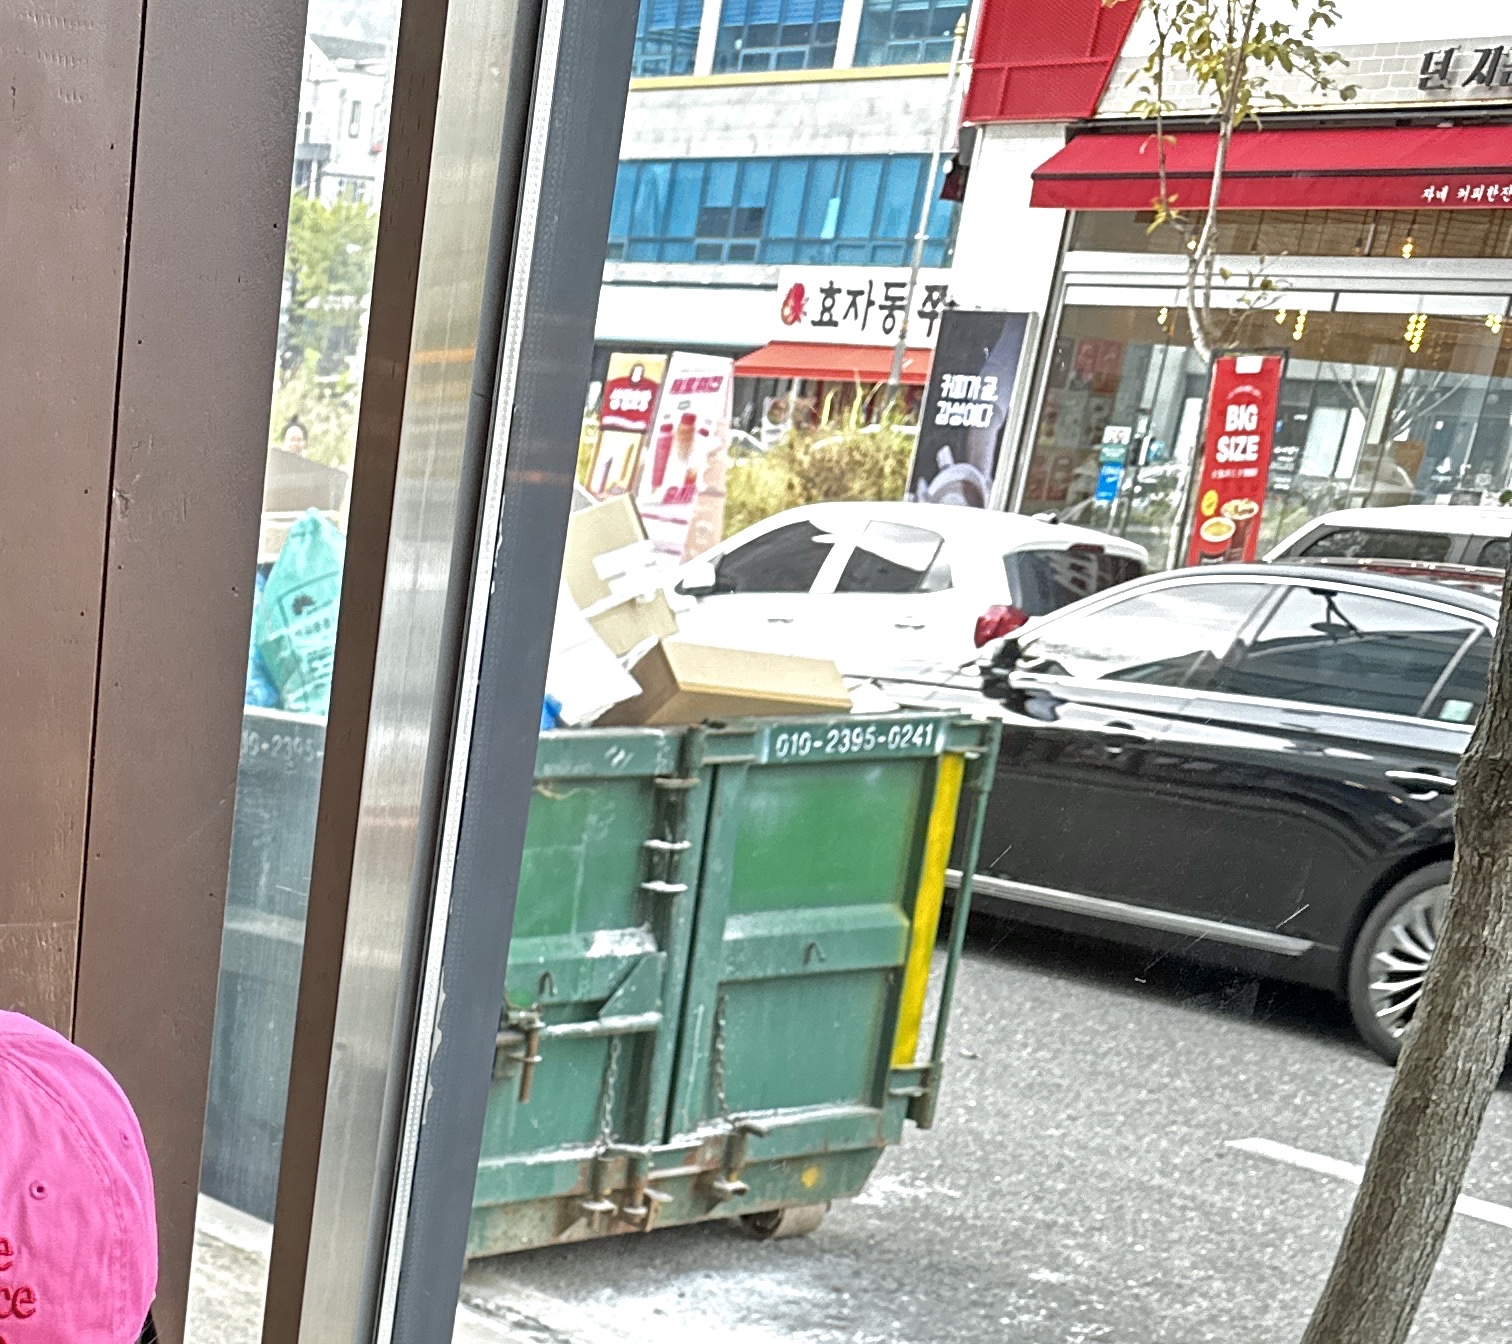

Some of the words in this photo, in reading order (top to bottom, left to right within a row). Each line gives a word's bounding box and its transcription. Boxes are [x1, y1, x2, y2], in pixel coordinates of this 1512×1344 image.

[1224, 403, 1259, 432] BIG
[1215, 434, 1261, 463] SIZE
[775, 722, 934, 758] 010-2395-0241
